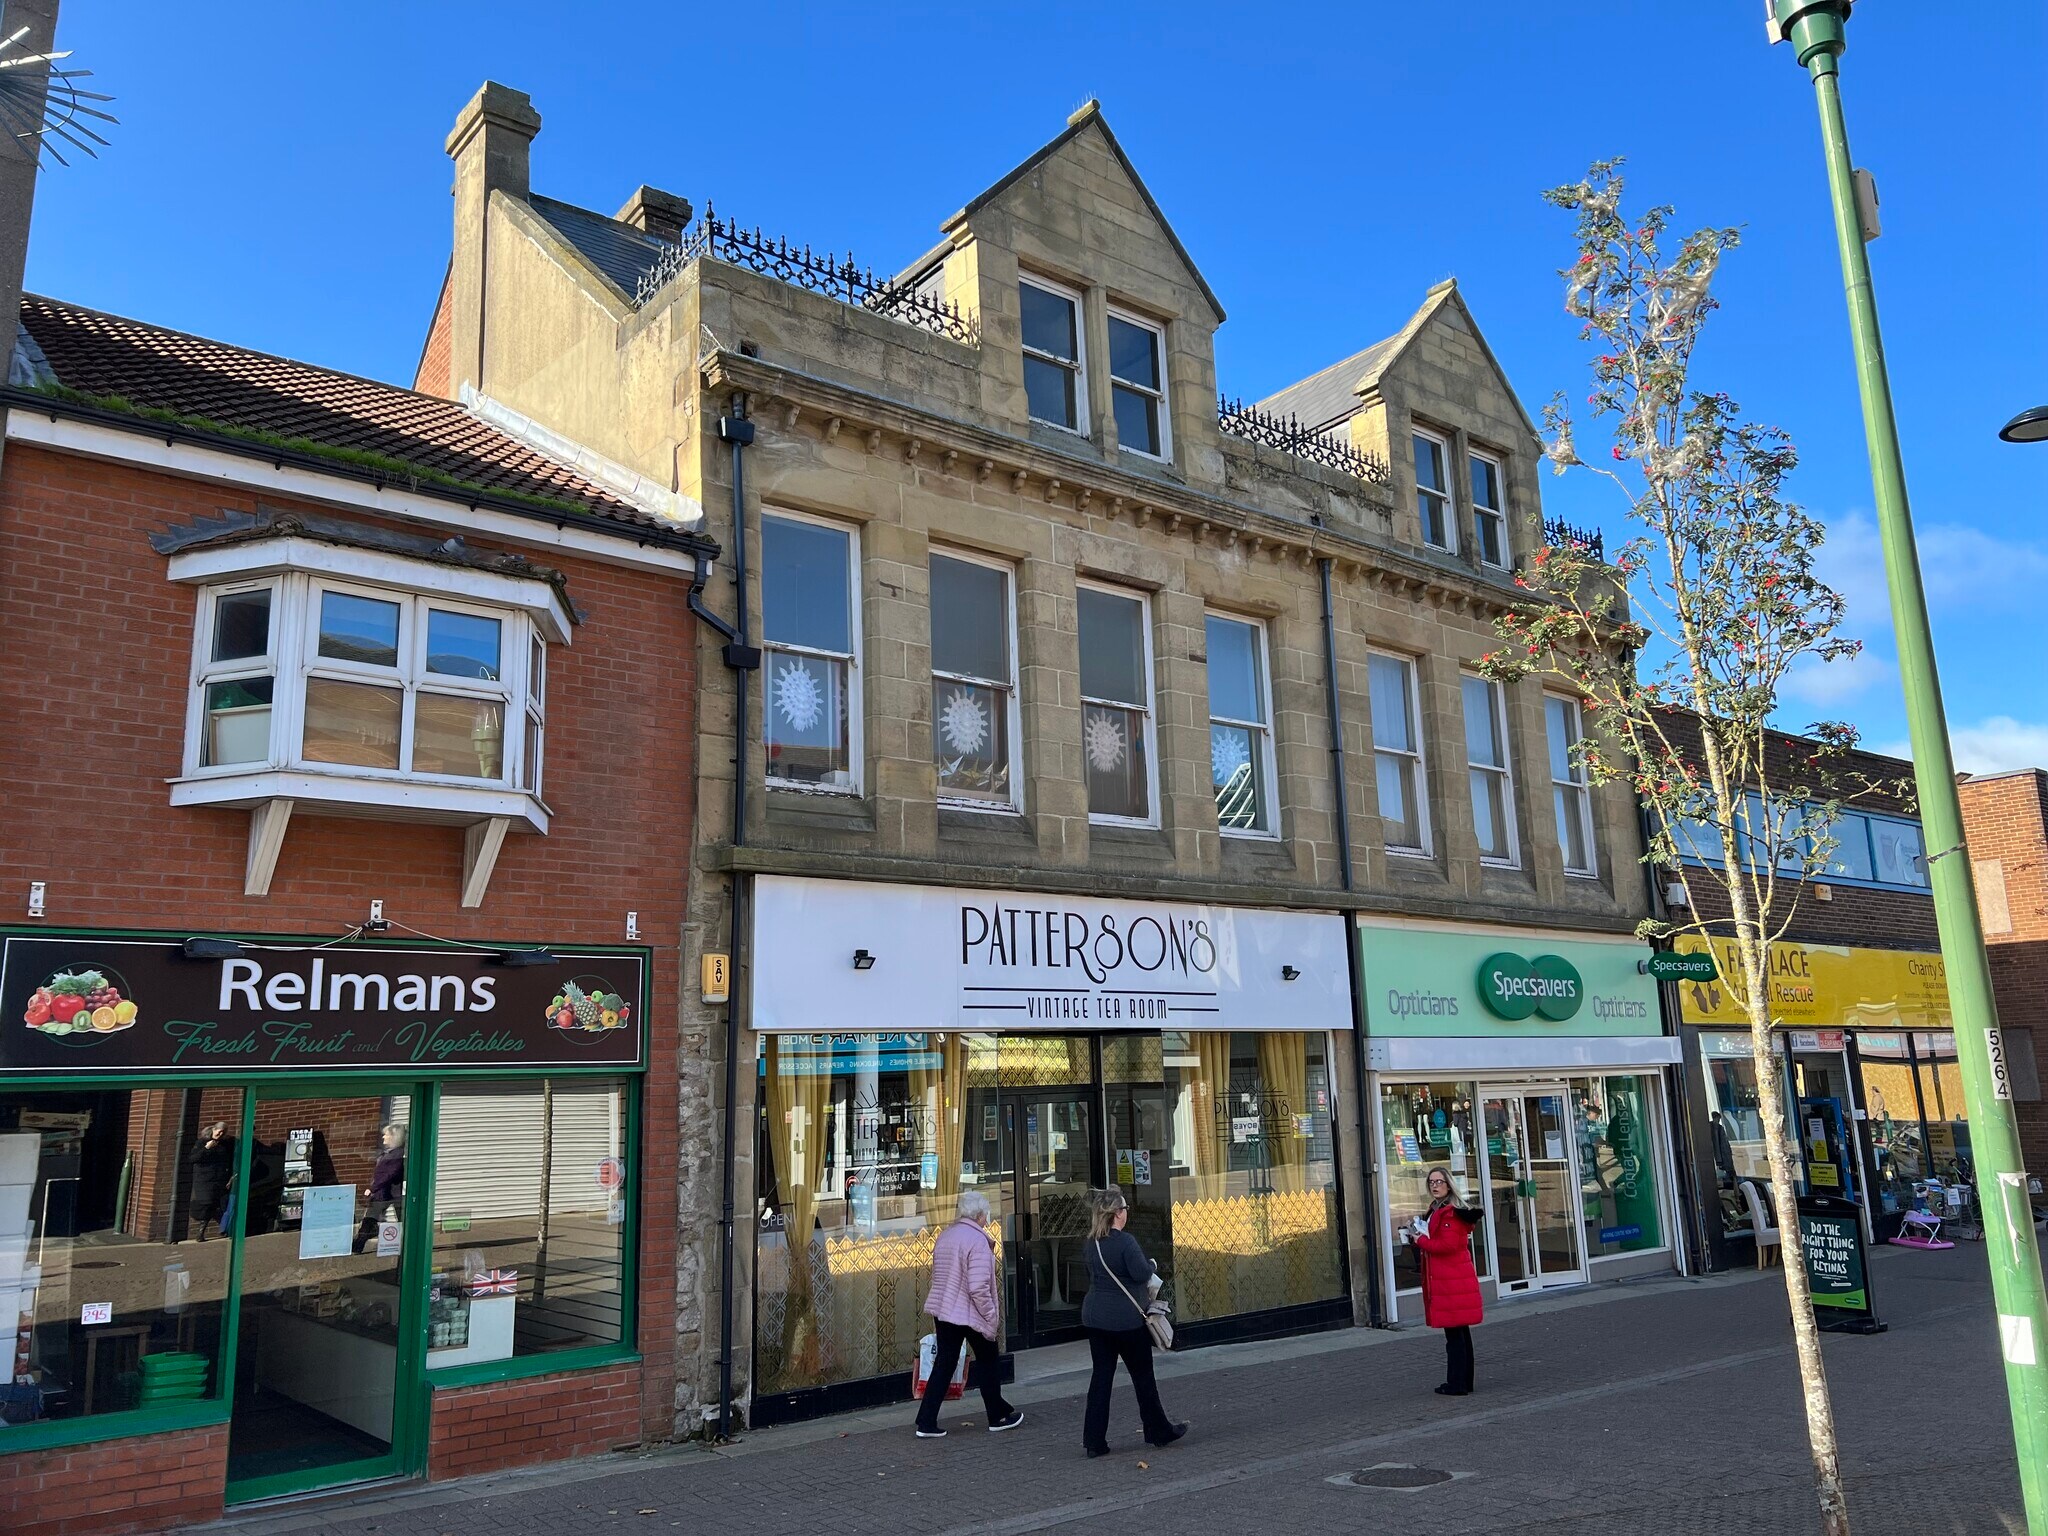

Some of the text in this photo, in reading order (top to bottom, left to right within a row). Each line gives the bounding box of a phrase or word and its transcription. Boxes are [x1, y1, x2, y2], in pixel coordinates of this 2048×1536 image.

[962, 901, 1217, 984] PATTERSON'S
[1654, 959, 1711, 972] Specsavers
[1727, 946, 1811, 977] FALACE
[1909, 960, 1937, 980] Charity
[219, 958, 496, 1012] Relmans
[1493, 971, 1576, 1001] Specsavers
[1776, 983, 1814, 1002] Rescue
[1028, 997, 1167, 1020] VINTAGE TEA ROOM
[1388, 989, 1459, 1020] Opticians
[1593, 995, 1647, 1021] Opticians
[1774, 1006, 1792, 1016] rejected
[1793, 1008, 1816, 1017] elsewhere
[163, 1019, 526, 1063] Fresh Fruit and Vegetables
[1990, 1030, 2008, 1098] 5264
[1622, 1147, 1637, 1198] Contact
[760, 1213, 792, 1228] OPEN
[1811, 1222, 1841, 1236] DO THE
[1802, 1234, 1854, 1250] RIGHT THING
[1810, 1248, 1849, 1261] FOR YOUR
[1813, 1260, 1847, 1274] RETINAS
[84, 1310, 107, 1322] 295
